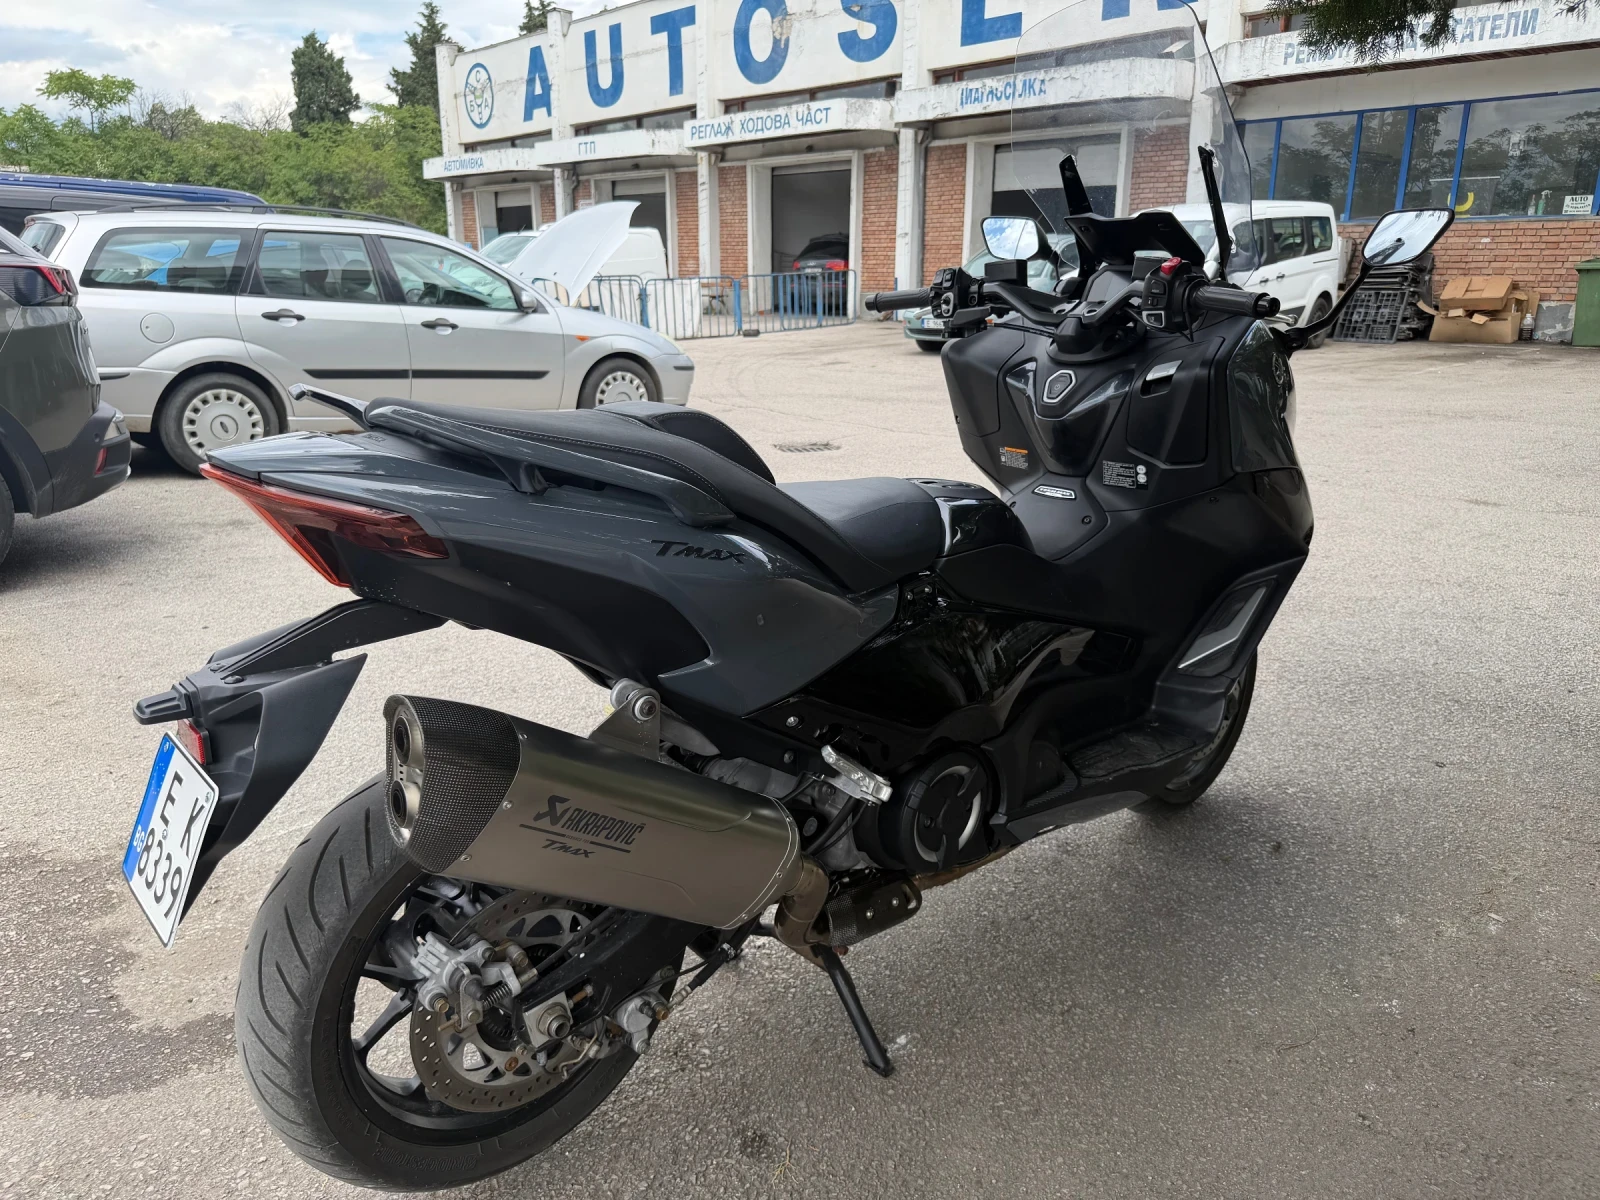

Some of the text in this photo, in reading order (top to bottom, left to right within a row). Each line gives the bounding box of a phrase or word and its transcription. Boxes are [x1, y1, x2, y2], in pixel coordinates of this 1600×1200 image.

[690, 107, 832, 141] РЕГЛАЖ ХОДОВА ЧАСТ
[578, 141, 596, 155] ГТП
[443, 156, 484, 172] АВТОМИВКА
[159, 770, 205, 859] E K
[133, 824, 145, 853] BG
[137, 827, 182, 919] 8339
